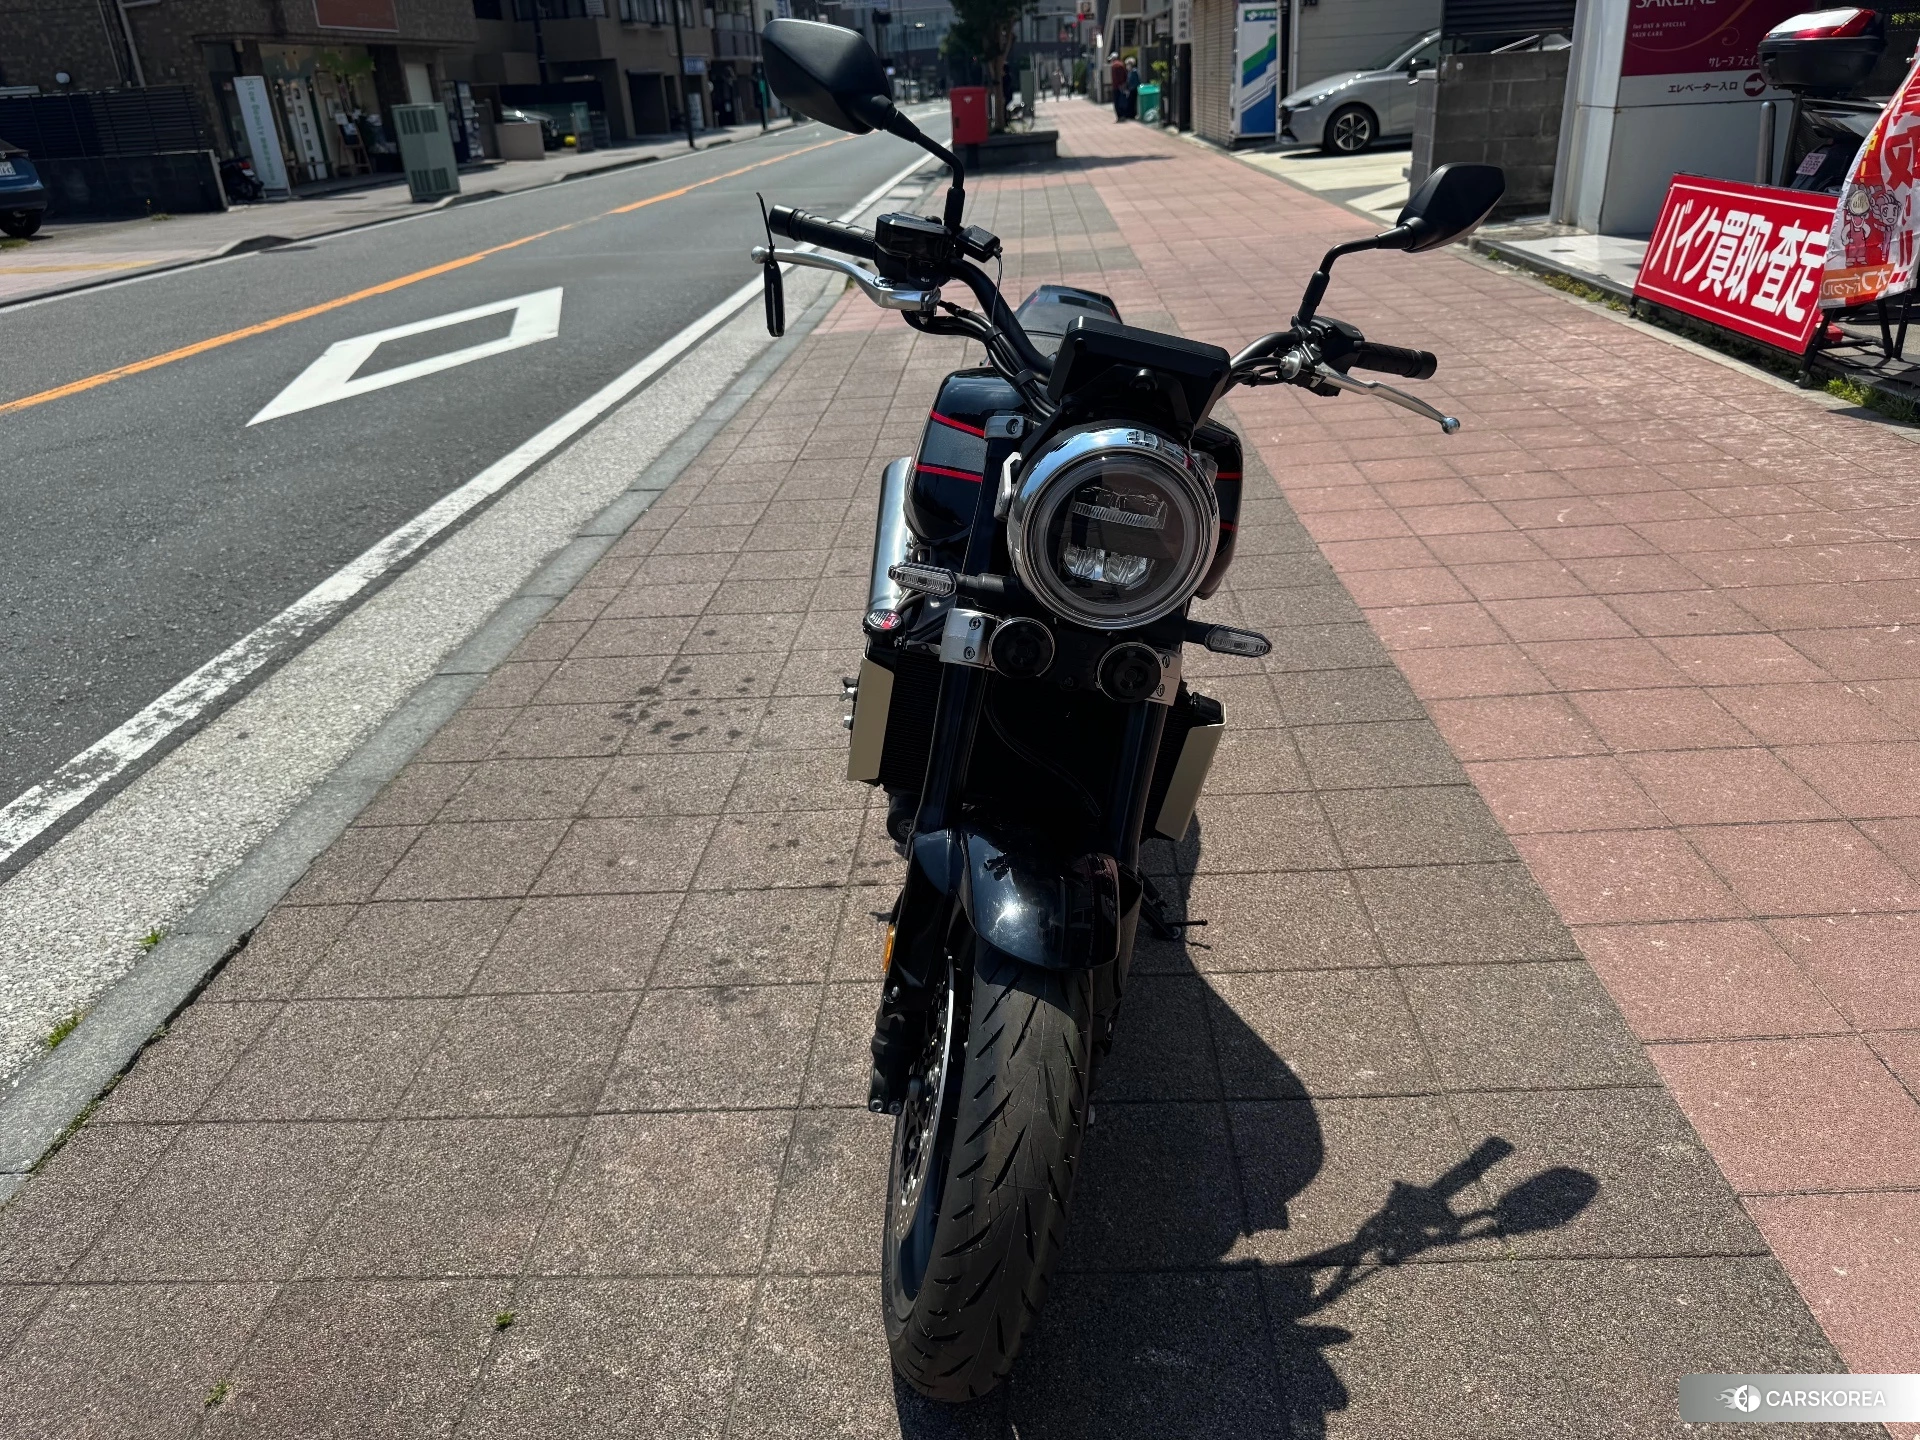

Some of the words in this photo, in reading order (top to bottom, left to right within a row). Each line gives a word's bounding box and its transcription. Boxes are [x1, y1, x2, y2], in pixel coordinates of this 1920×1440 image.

[1708, 56, 1734, 68] サレーヌ
[1737, 55, 1760, 66] フェイ
[1667, 81, 1738, 94] エレベーター入口
